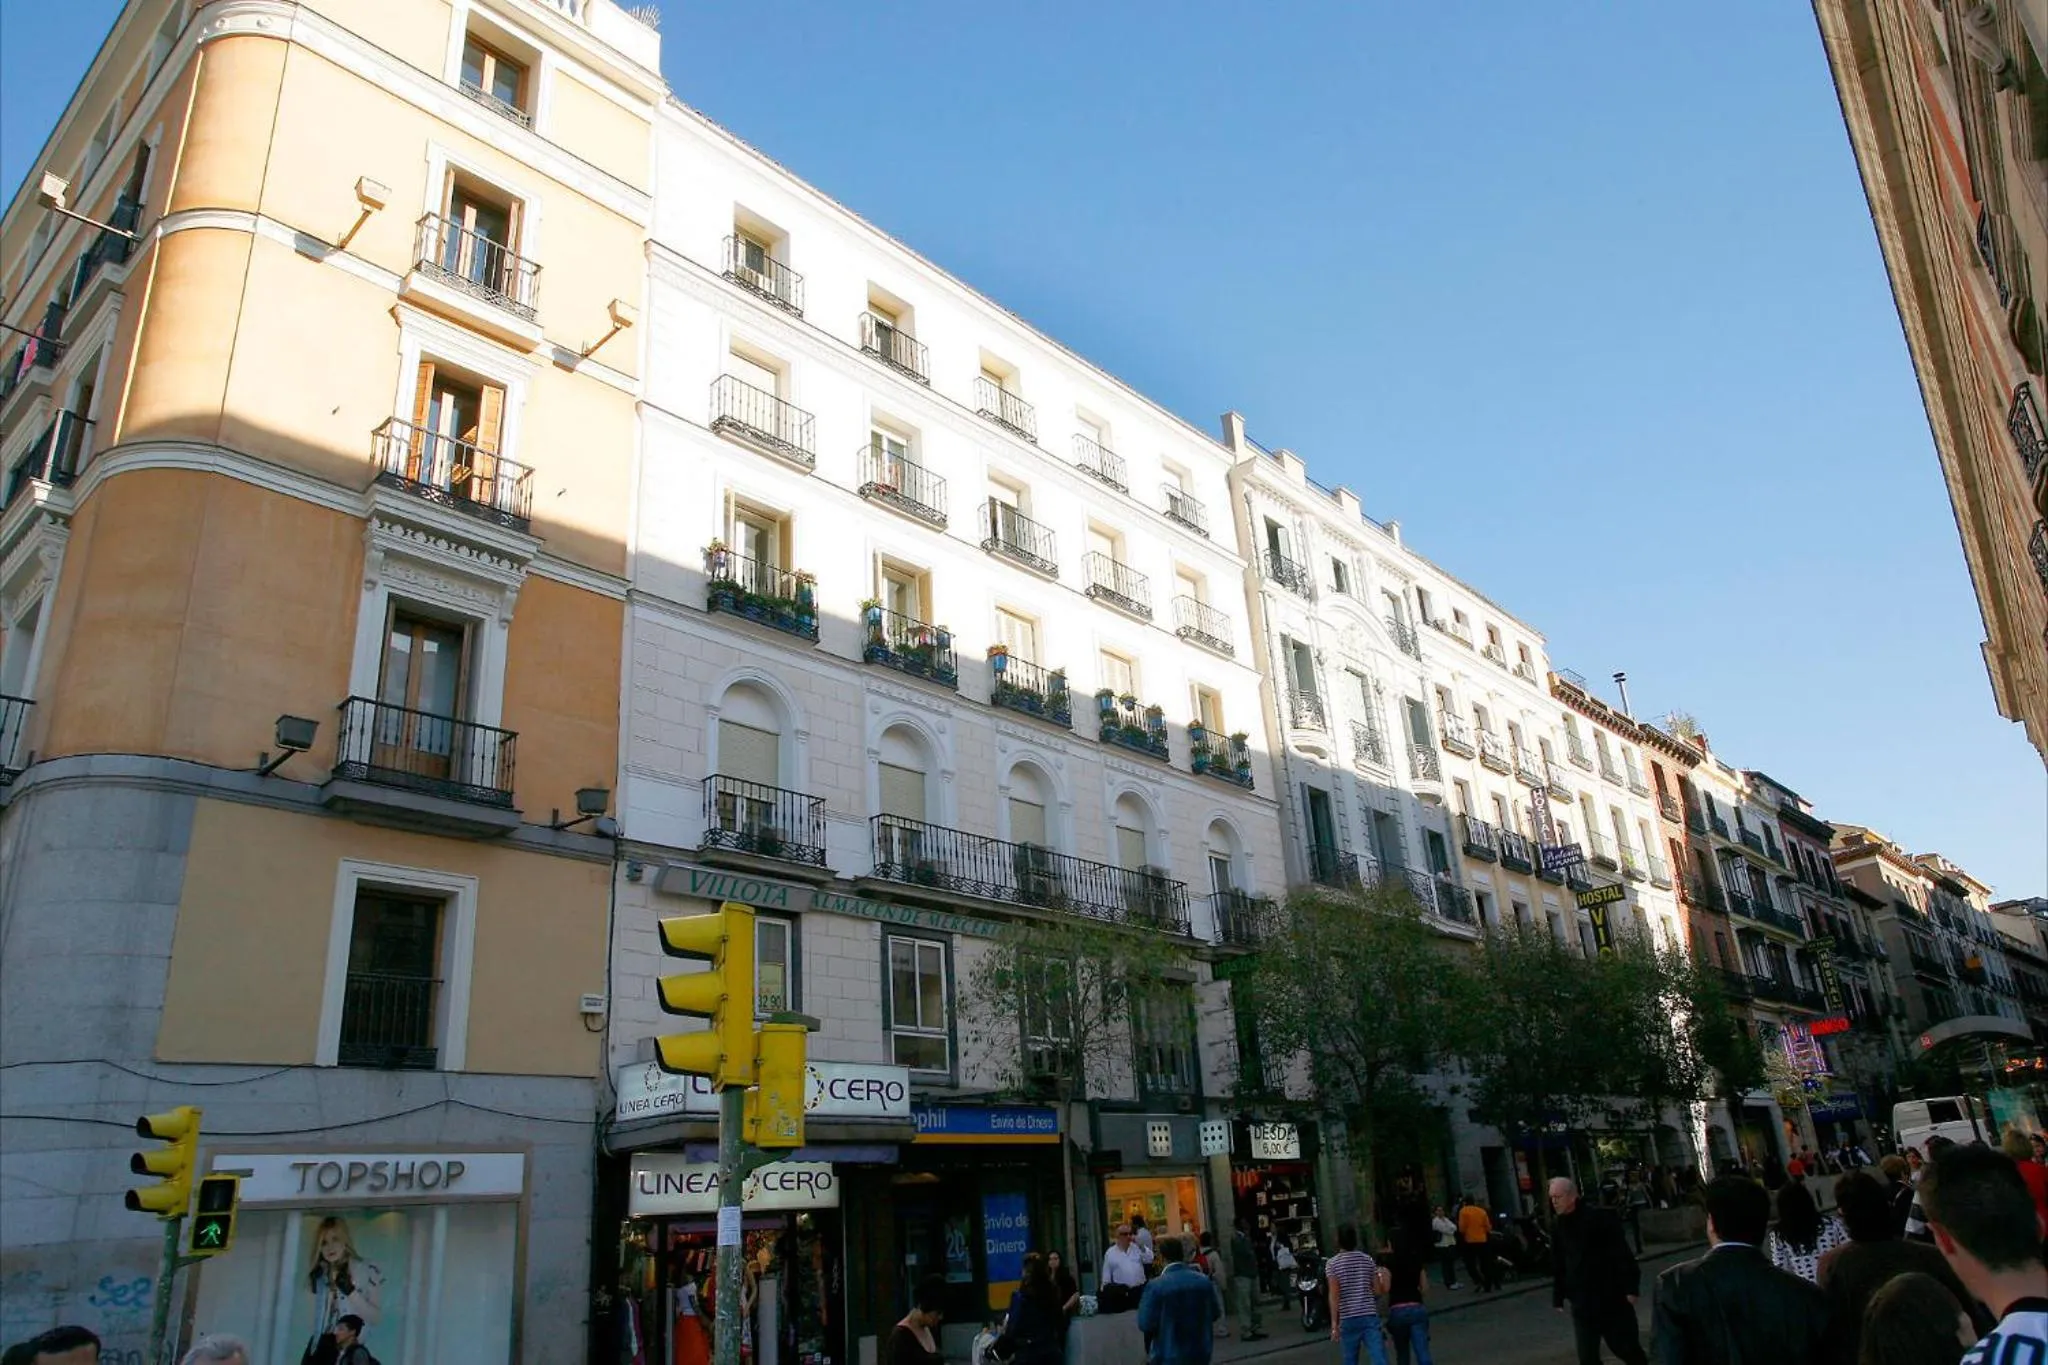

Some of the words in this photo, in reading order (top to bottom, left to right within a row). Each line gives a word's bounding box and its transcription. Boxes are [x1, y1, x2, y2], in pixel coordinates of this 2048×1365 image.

[1532, 788, 1551, 841] HOSTAL
[689, 871, 788, 907] VILLOTA
[1578, 887, 1623, 907] HOSTAL
[899, 907, 919, 925] DE
[926, 911, 1003, 939] MERCERI
[619, 1098, 650, 1114] LINEA
[653, 1093, 684, 1110] CERO
[828, 1078, 905, 1111] CERO
[1015, 1114, 1027, 1129] de
[1027, 1115, 1054, 1129] Dinero
[291, 1160, 465, 1194] TOPSHOP
[639, 1171, 720, 1195] LINEA
[763, 1171, 832, 1199] CERO
[986, 1239, 1026, 1255] Dinero
